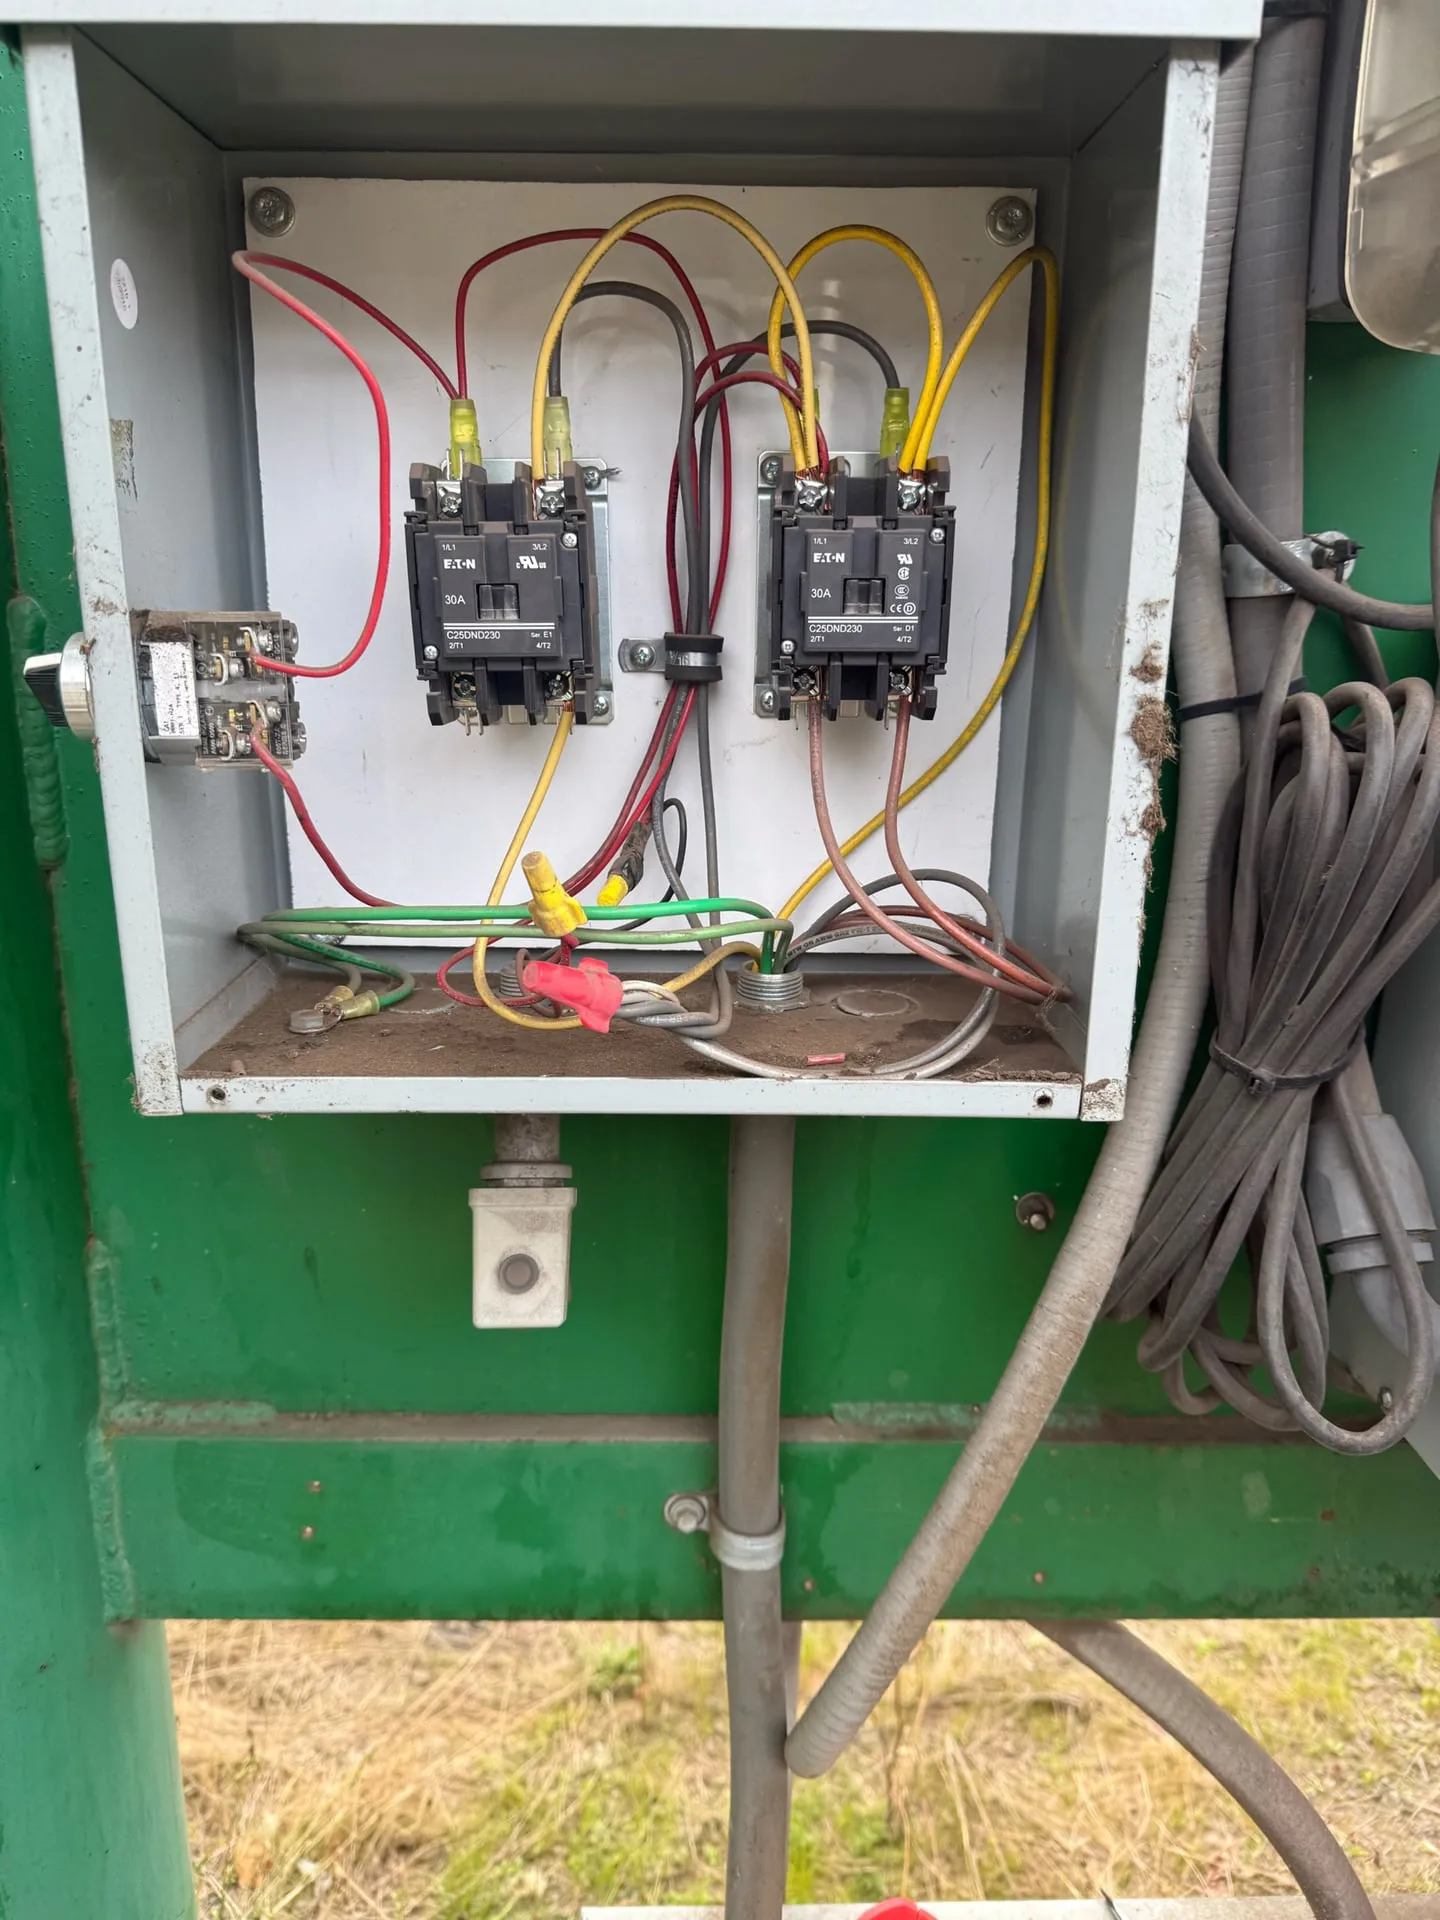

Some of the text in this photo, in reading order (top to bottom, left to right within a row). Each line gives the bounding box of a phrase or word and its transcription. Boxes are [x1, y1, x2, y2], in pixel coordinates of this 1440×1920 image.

[811, 588, 832, 598] 30A
[445, 594, 466, 605] 30A
[809, 624, 863, 633] C25DND230
[446, 630, 501, 640] C25DND230
